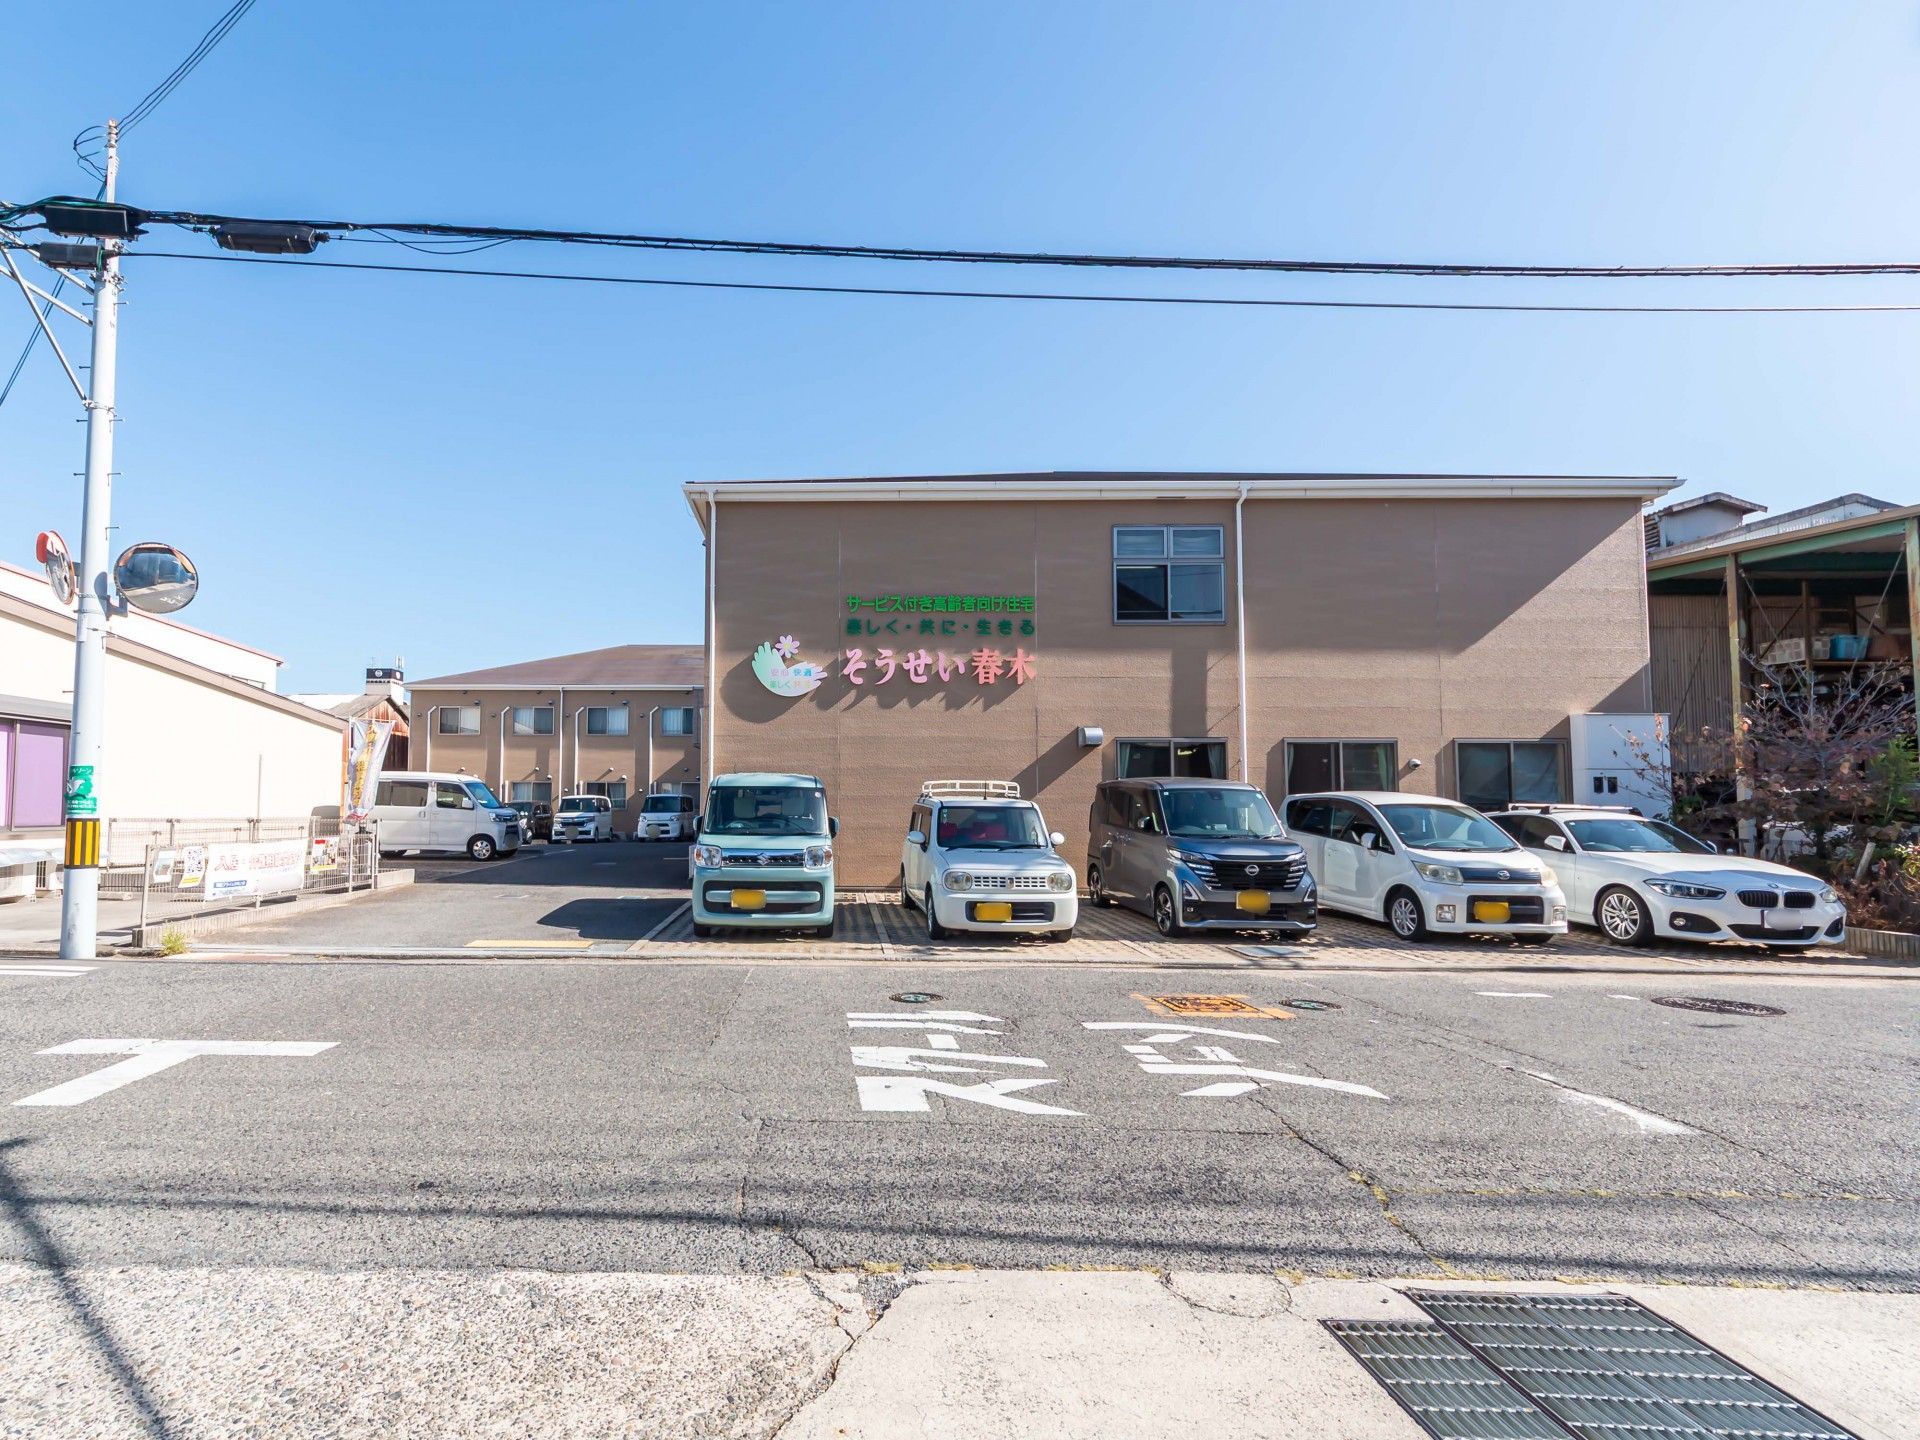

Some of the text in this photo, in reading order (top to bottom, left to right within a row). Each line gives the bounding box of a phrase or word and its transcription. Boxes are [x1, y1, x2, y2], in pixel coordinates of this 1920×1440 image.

[847, 595, 1034, 612] サービス付き高齢者向け住宅
[843, 648, 1036, 684] そうせい春木
[847, 1010, 1089, 1116] スクール
[1081, 1022, 1391, 1100] ゾーン
